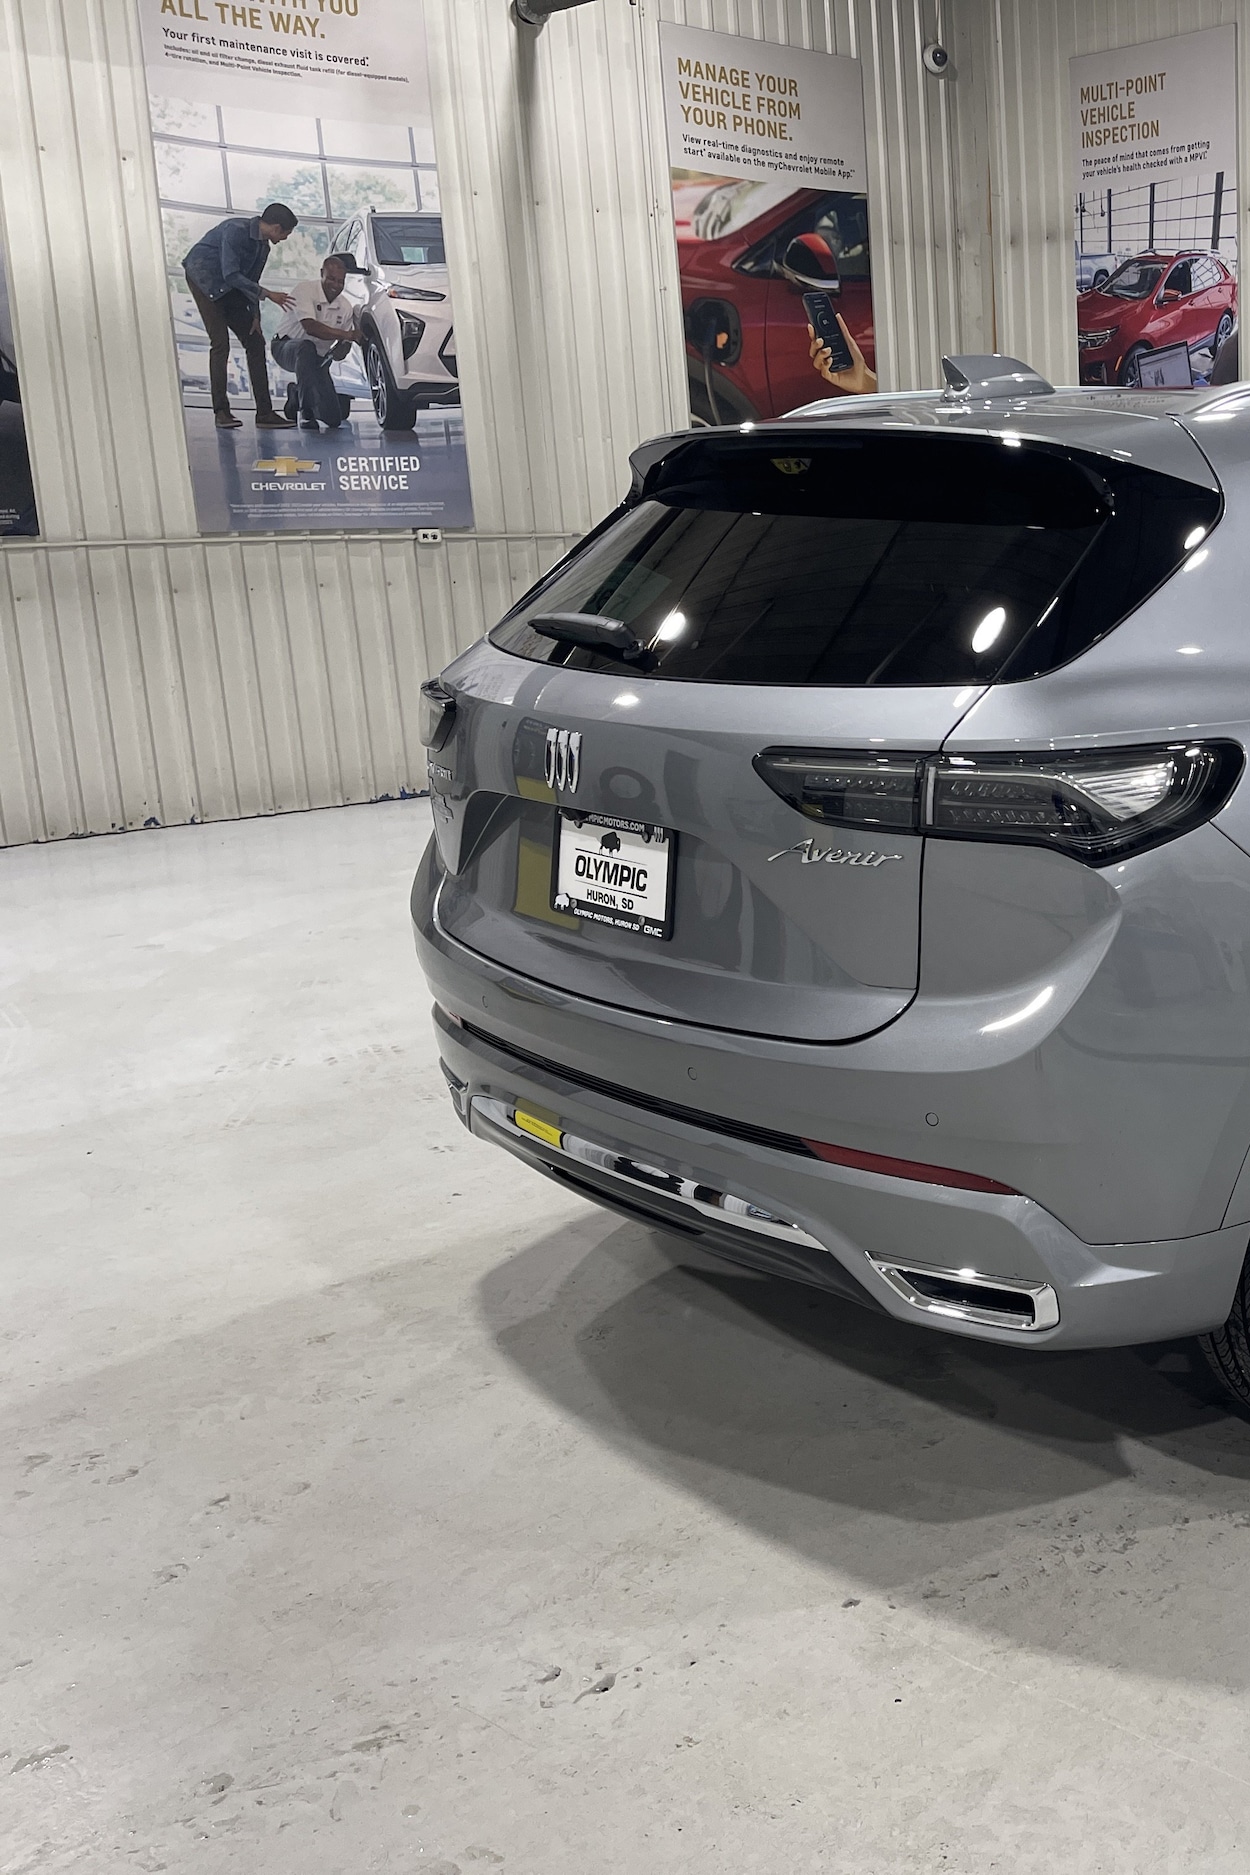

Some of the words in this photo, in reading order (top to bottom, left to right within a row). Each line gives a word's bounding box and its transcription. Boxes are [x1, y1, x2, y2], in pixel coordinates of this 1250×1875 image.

[160, 0, 209, 21] ALL
[214, 2, 263, 30] THE
[268, 10, 326, 39] WAY.
[162, 27, 188, 41] Your
[191, 32, 217, 46] first
[219, 38, 288, 57] maintenance
[290, 48, 312, 60] visit
[315, 51, 324, 61] is
[677, 57, 751, 89] MANAGE
[755, 72, 799, 98] YOUR
[1080, 72, 1167, 105] MULTI-POINT
[678, 80, 752, 112] VEHICLE
[756, 95, 801, 120] FROM
[1080, 101, 1136, 127] VEHICLE
[680, 104, 727, 131] YOUR
[732, 114, 793, 141] PHONE.
[1081, 119, 1159, 149] INSPECTION
[682, 133, 701, 145] View
[703, 138, 739, 152] real-time
[741, 144, 783, 159] diagnostics
[784, 152, 798, 161] and
[799, 153, 818, 165] enjoy
[819, 157, 845, 166] remote
[707, 150, 741, 164] available
[742, 157, 752, 165] on
[753, 158, 766, 168] the
[767, 161, 813, 174] myChevrolet
[814, 167, 836, 177] Mobile
[1082, 158, 1093, 167] The
[1093, 157, 1111, 168] peace
[1112, 153, 1119, 162] of
[1119, 151, 1134, 161] mind
[1135, 150, 1148, 159] that
[1149, 147, 1169, 157] comes
[1170, 145, 1186, 153] from
[1187, 140, 1210, 153] getting
[1082, 170, 1095, 180] your
[1096, 163, 1121, 176] vehicle's
[1122, 161, 1142, 172] health
[1142, 158, 1168, 169] checked
[1169, 155, 1183, 165] with
[336, 456, 421, 472] CERTIFIED
[251, 482, 327, 491] CHEVROLET
[339, 475, 409, 490] SERVICE
[586, 814, 645, 832] MPICMOTORS.COM
[767, 838, 903, 867] Avenir
[575, 855, 648, 892] OLYMPIC
[586, 889, 619, 910] HURON,
[621, 897, 634, 911] SD
[573, 907, 593, 919] OLYMPIC
[593, 913, 615, 925] MOTORS,
[614, 918, 632, 929] HURON
[632, 922, 640, 931] SD
[643, 924, 663, 938] GMC
